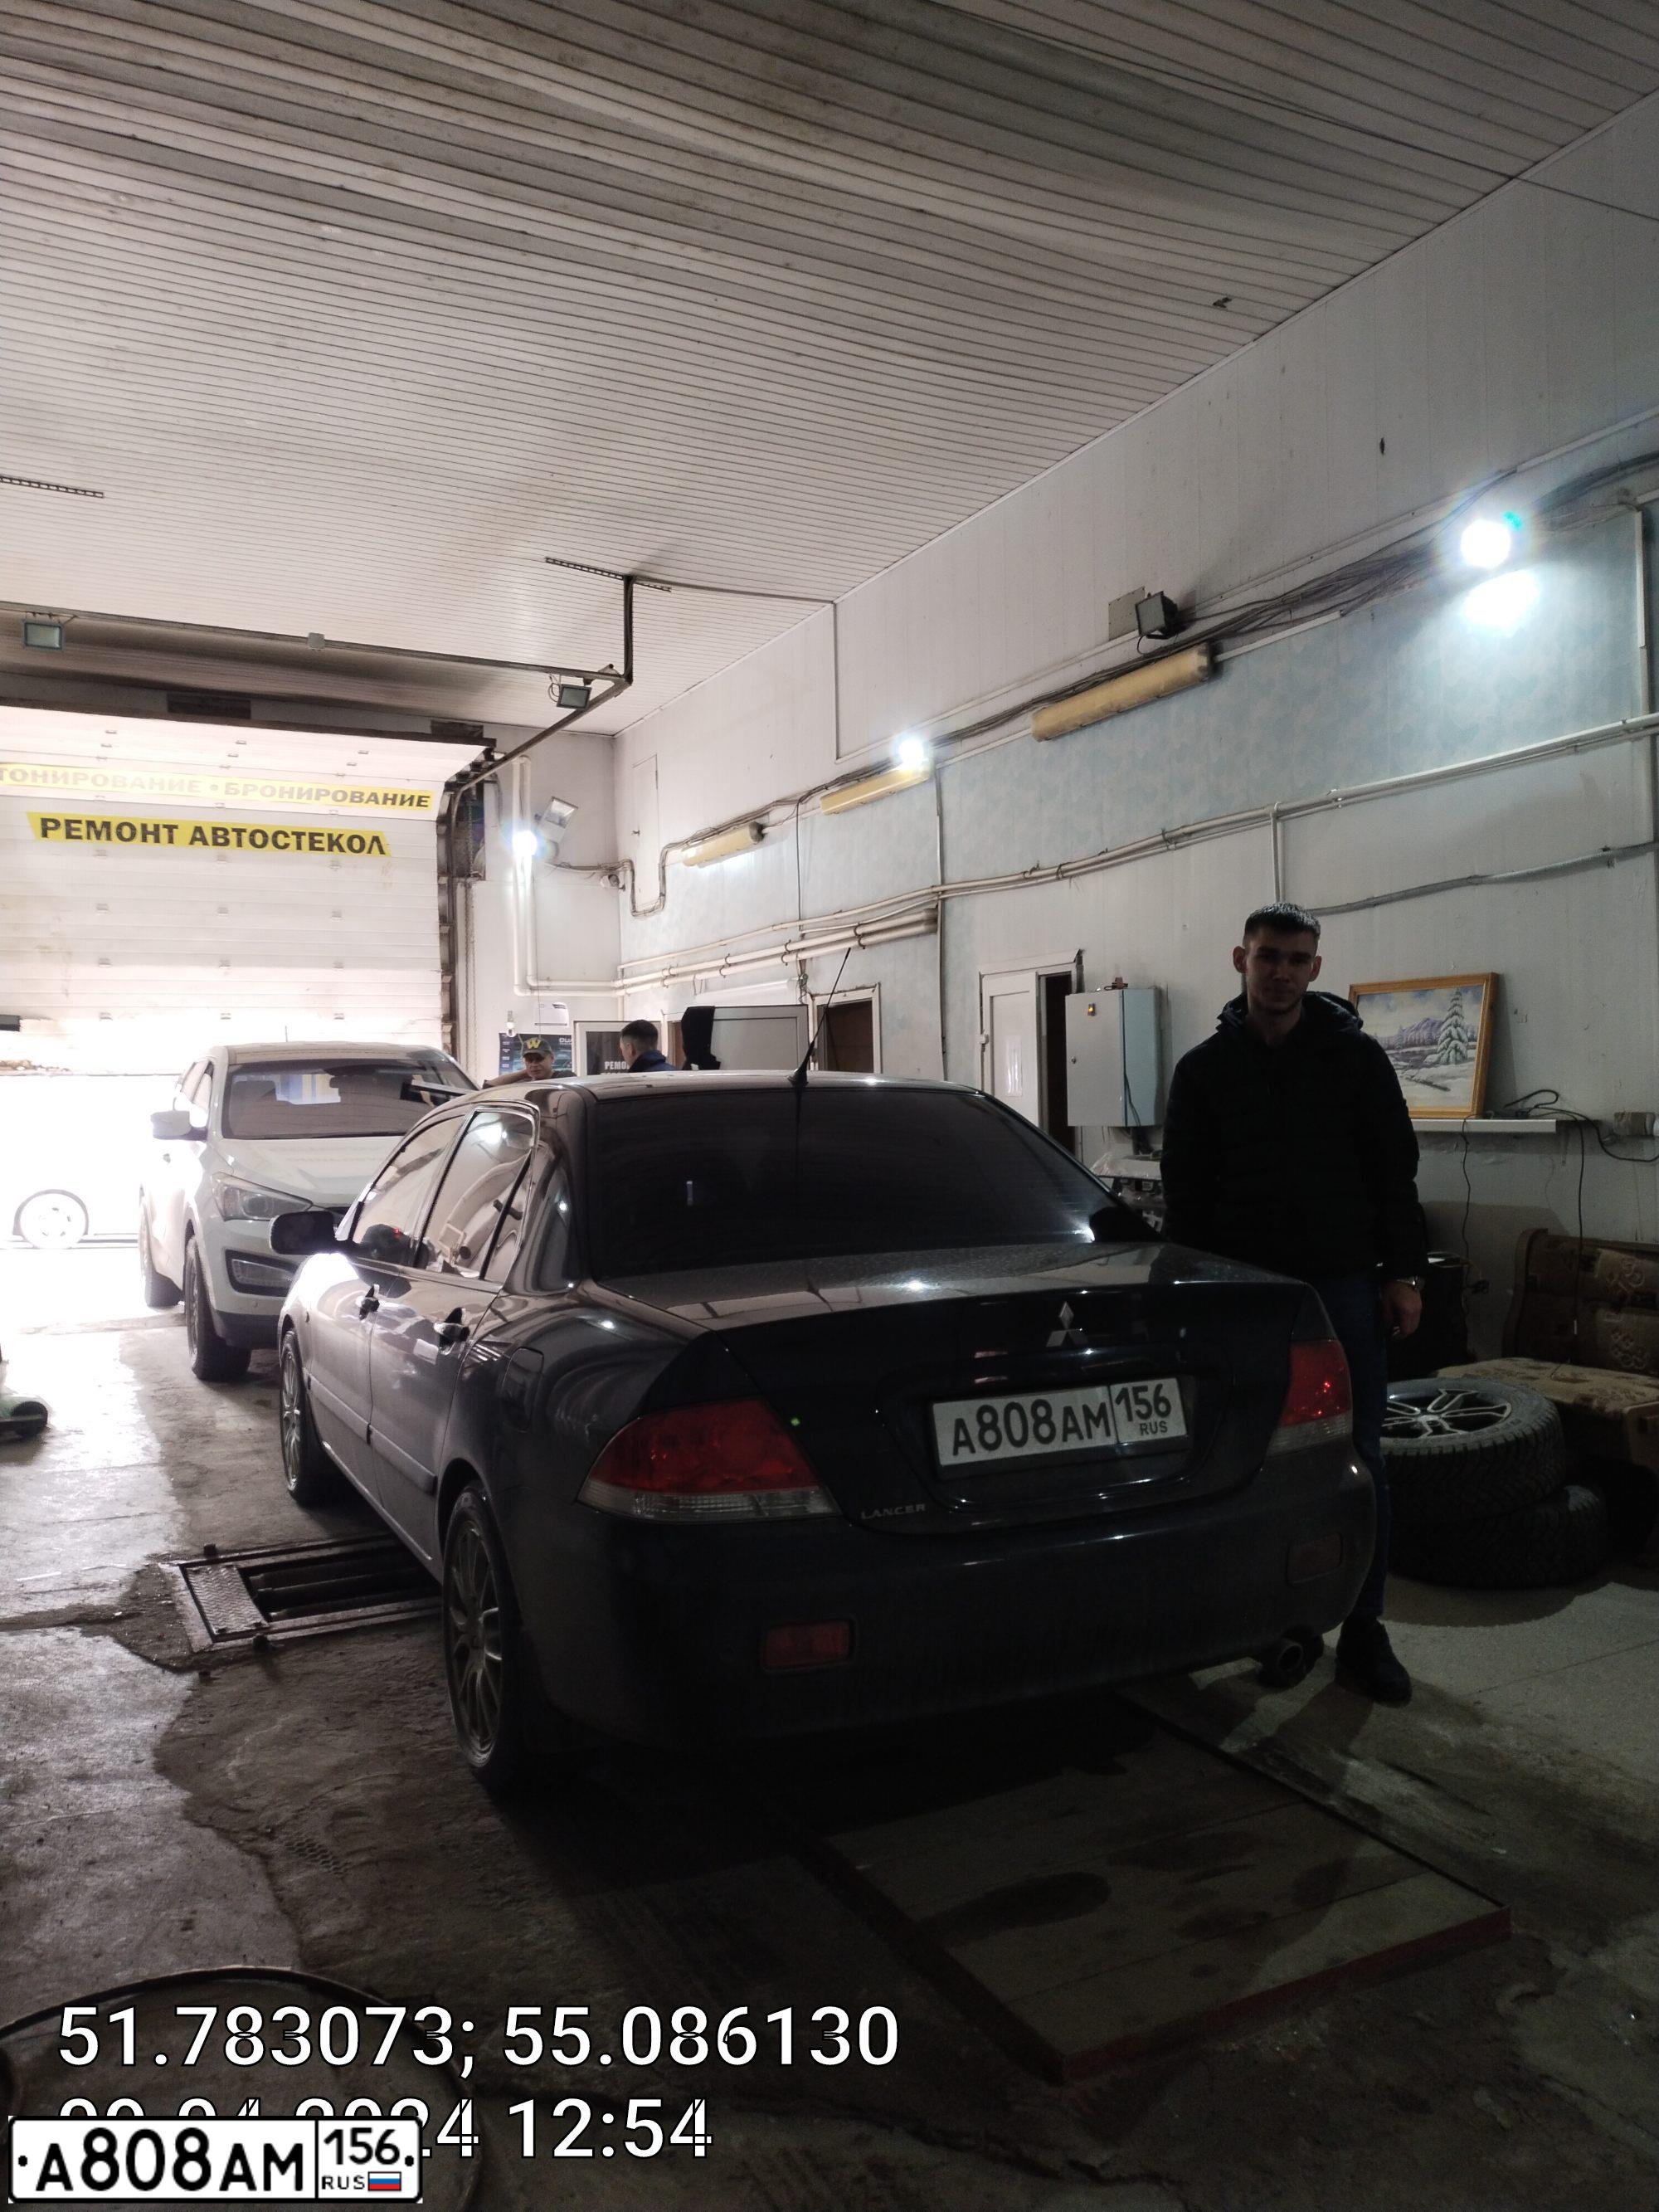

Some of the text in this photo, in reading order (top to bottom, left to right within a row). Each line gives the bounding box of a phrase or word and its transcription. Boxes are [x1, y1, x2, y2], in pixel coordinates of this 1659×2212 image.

[224, 781, 431, 808] БРОНИРОВАНИЕ
[40, 817, 387, 855] РЕМОНТ АВТОСТЕКОЛ
[1115, 1384, 1172, 1422] 156
[1139, 1420, 1169, 1435] RUS
[860, 1503, 926, 1519] LANCER
